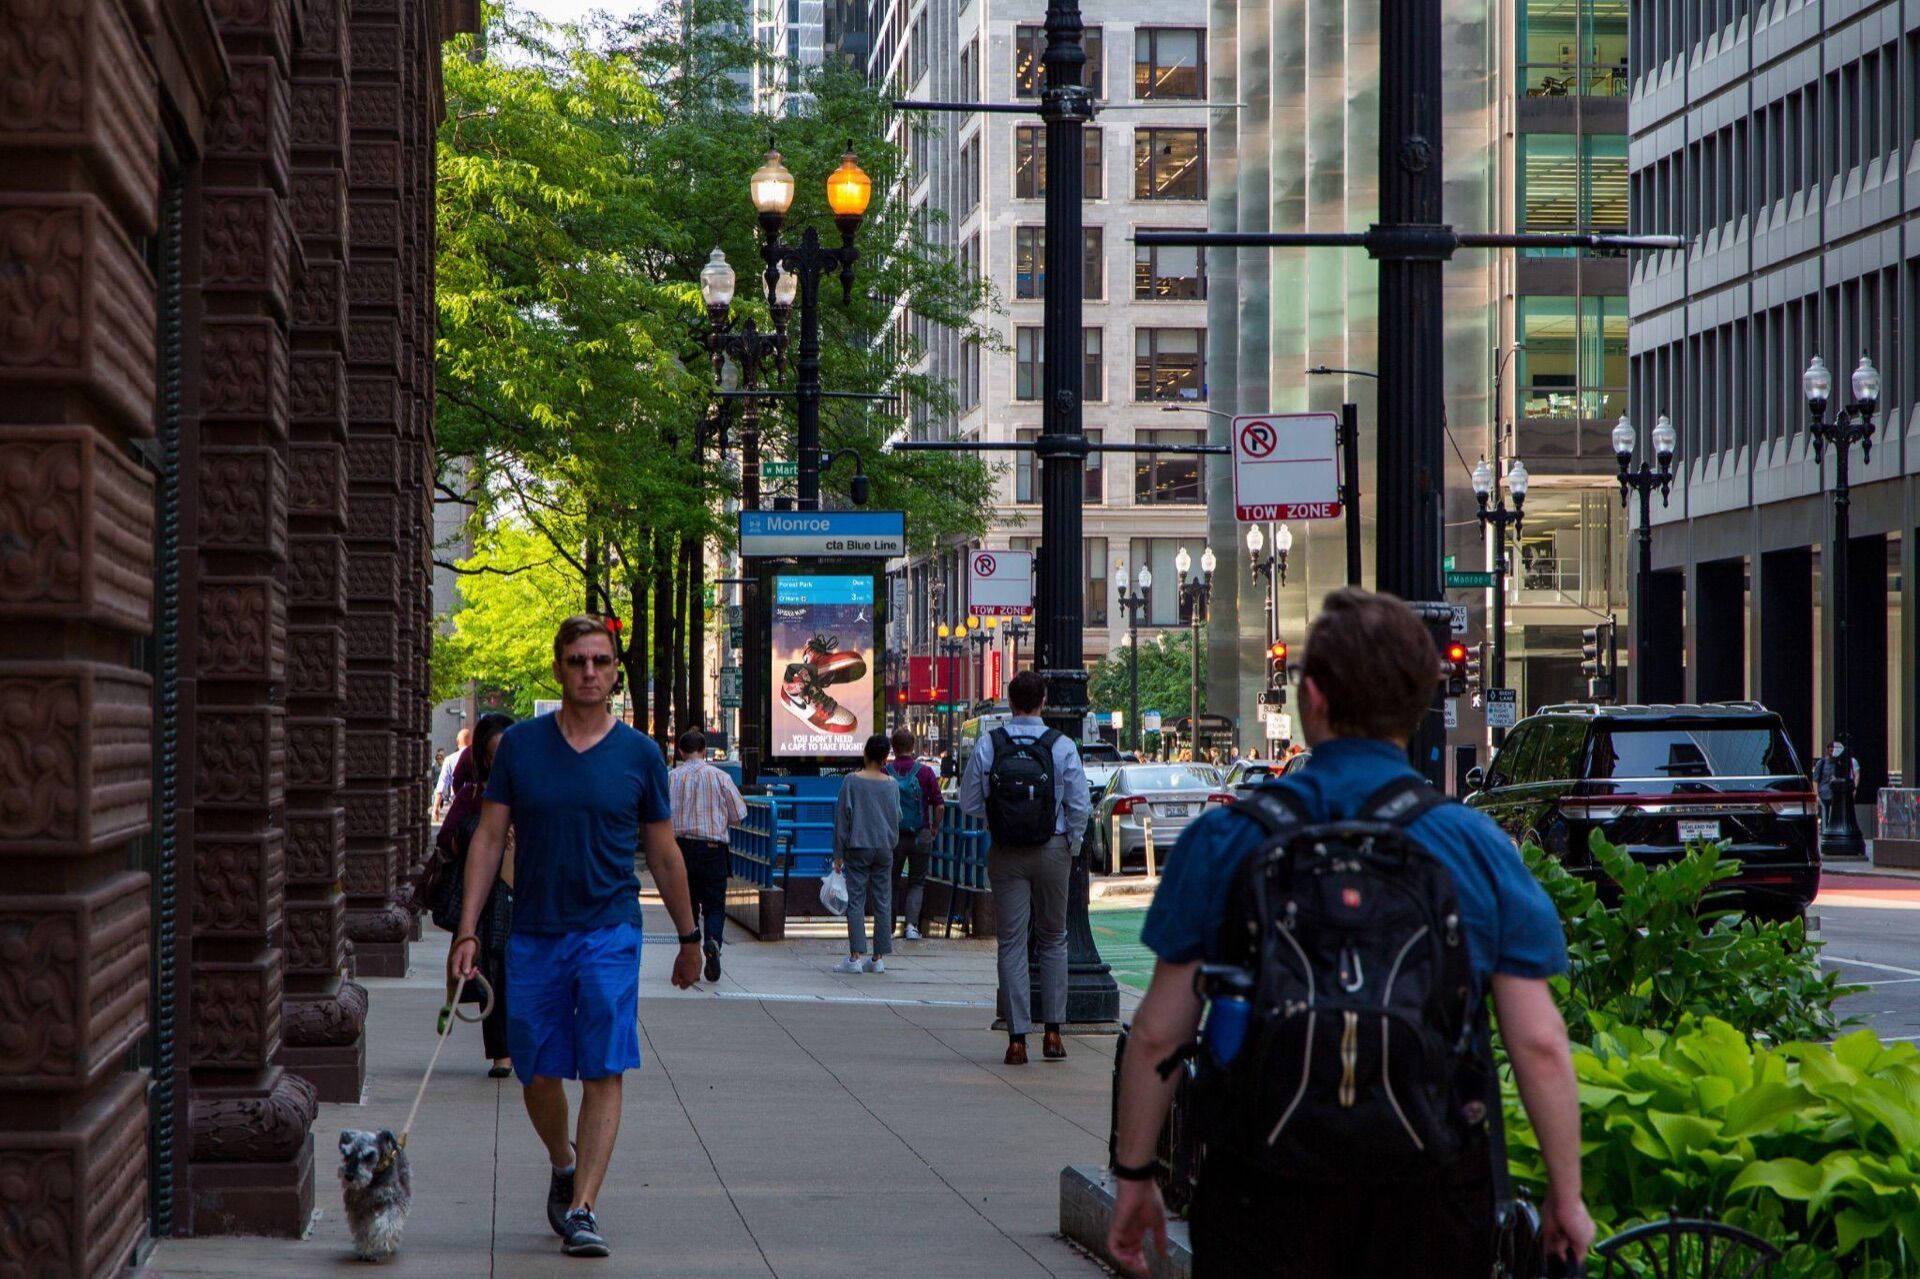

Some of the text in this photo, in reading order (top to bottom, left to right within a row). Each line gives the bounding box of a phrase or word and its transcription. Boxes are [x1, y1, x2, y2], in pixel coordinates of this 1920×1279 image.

[1242, 503, 1332, 520] TOW ZONE
[767, 517, 830, 531] Monroe
[826, 540, 897, 550] cta Blue Line
[1453, 576, 1483, 585] Monroe
[973, 607, 1027, 615] TOW ZONE
[792, 735, 854, 743] YOU DON'T NEED
[780, 743, 787, 751] A
[787, 743, 807, 751] CAPE
[808, 743, 818, 751] TO
[819, 743, 837, 751] TAKE
